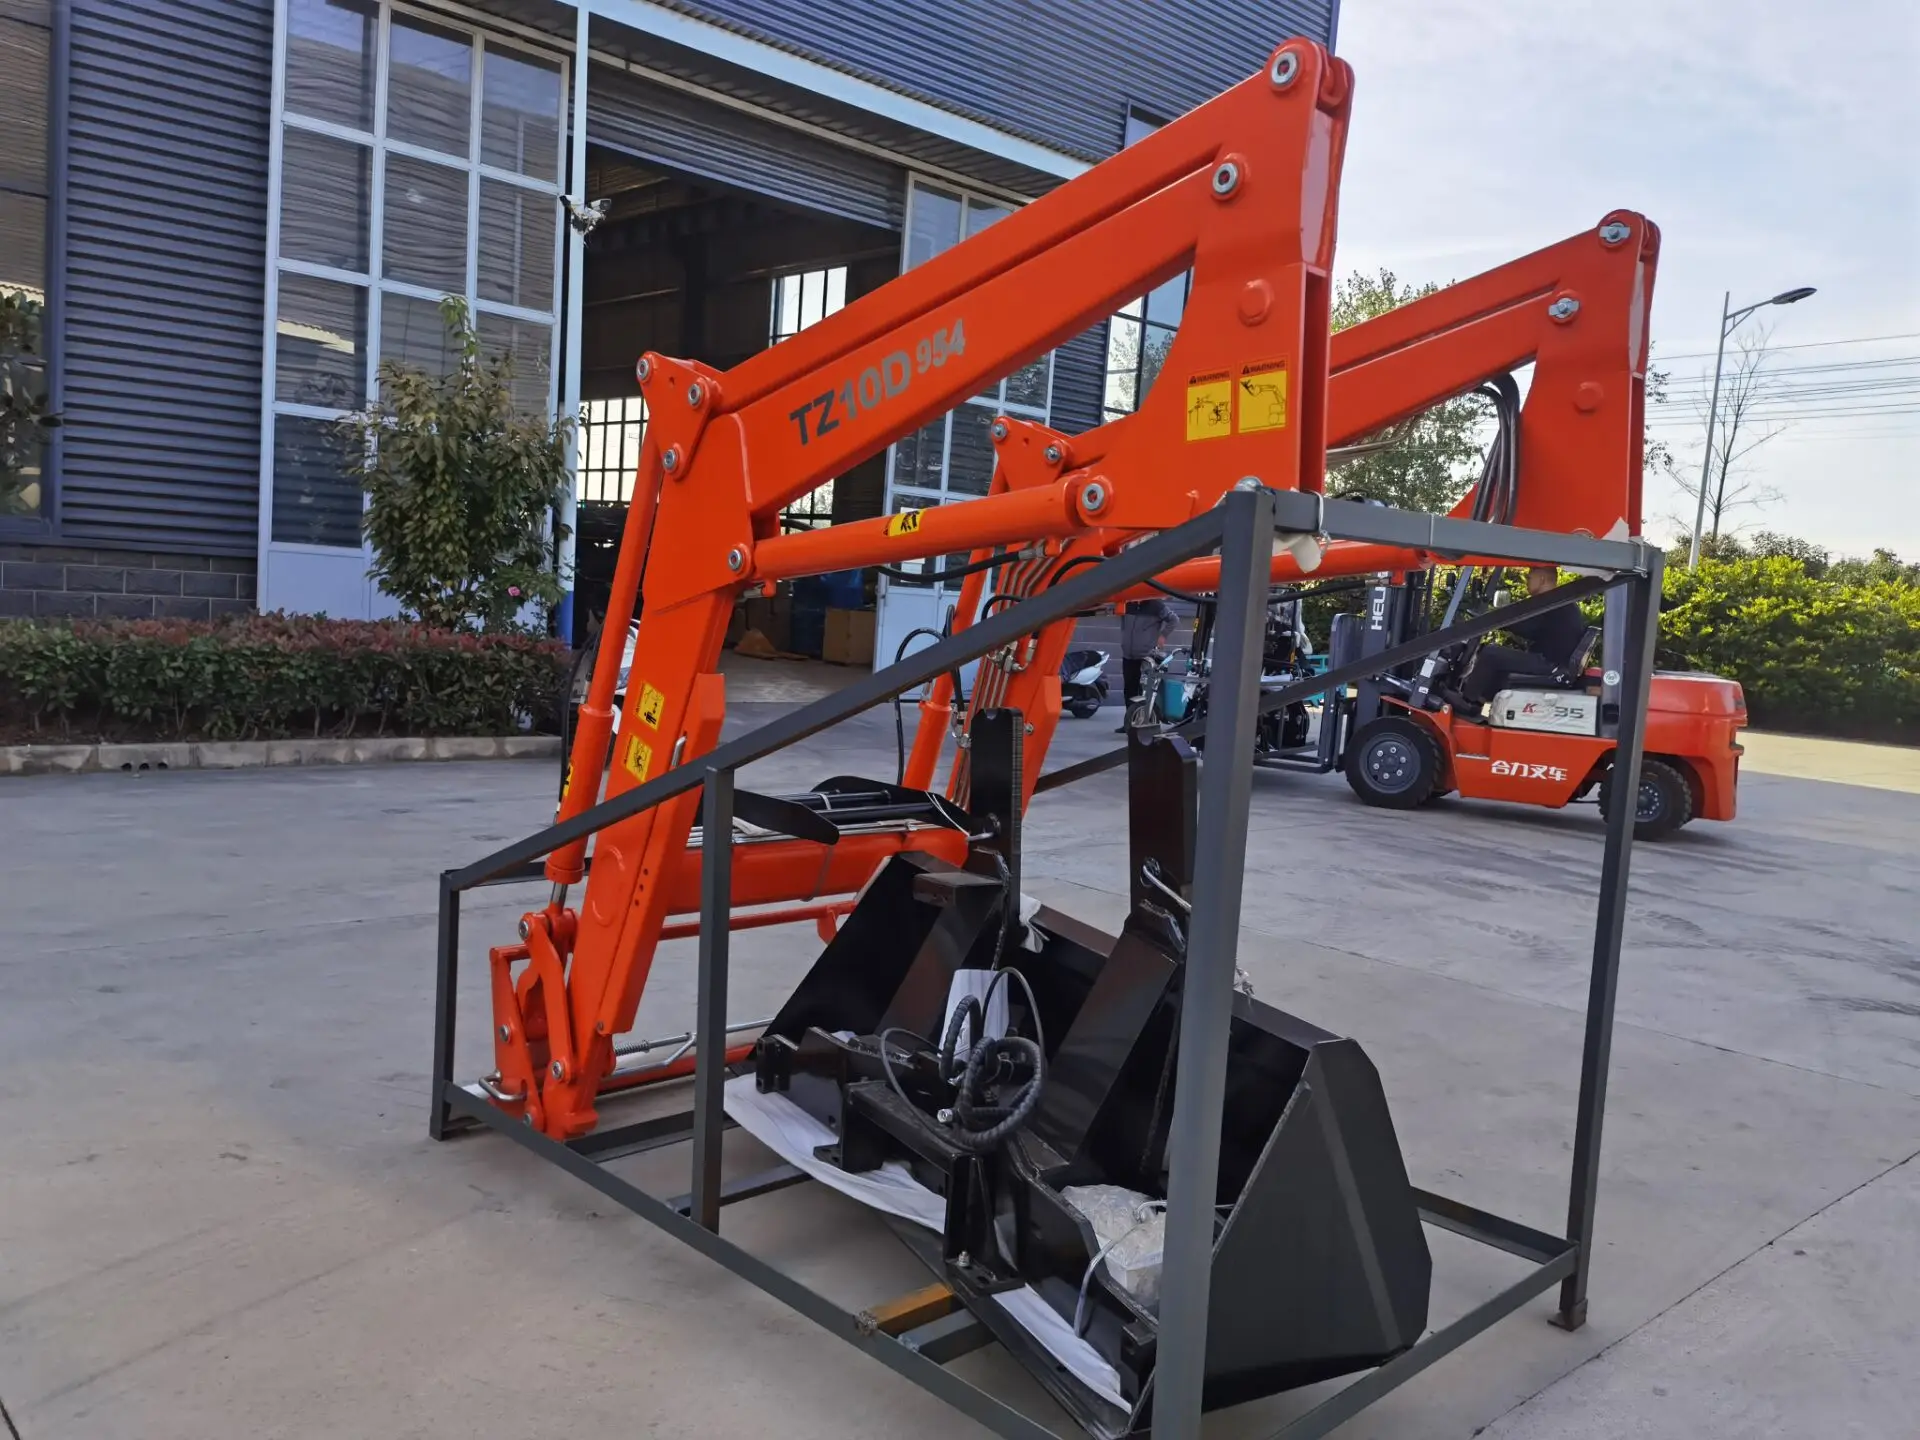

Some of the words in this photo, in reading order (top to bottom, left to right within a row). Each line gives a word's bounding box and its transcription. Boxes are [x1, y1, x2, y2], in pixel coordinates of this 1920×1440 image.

[1250, 360, 1286, 373] WARNING
[789, 351, 912, 446] TZ10D
[916, 318, 966, 374] 954
[1554, 706, 1585, 719] 35
[1490, 759, 1569, 782] 合力叉车
